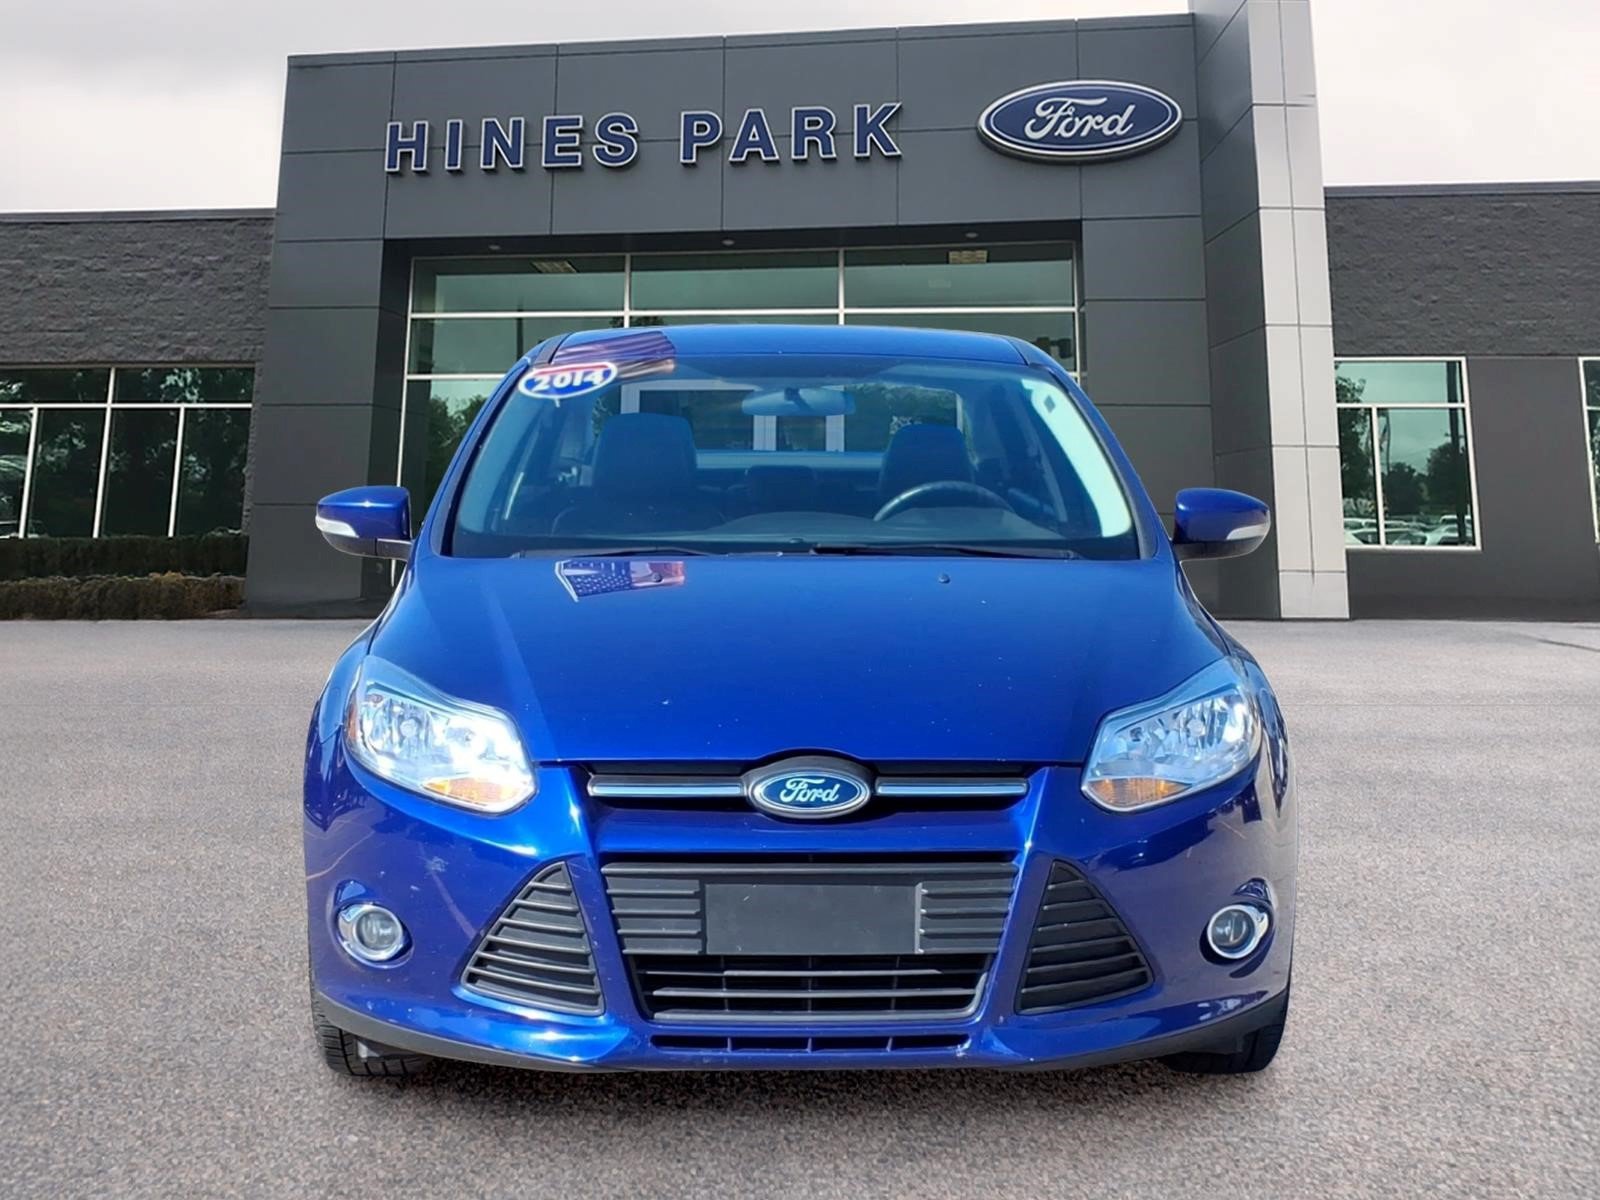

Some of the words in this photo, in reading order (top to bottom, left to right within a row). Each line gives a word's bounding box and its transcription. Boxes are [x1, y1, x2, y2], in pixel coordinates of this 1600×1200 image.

[1024, 97, 1136, 140] Ford
[385, 112, 639, 172] HINES
[680, 102, 902, 164] PARK
[531, 369, 605, 393] 2014
[780, 777, 841, 802] Ford
